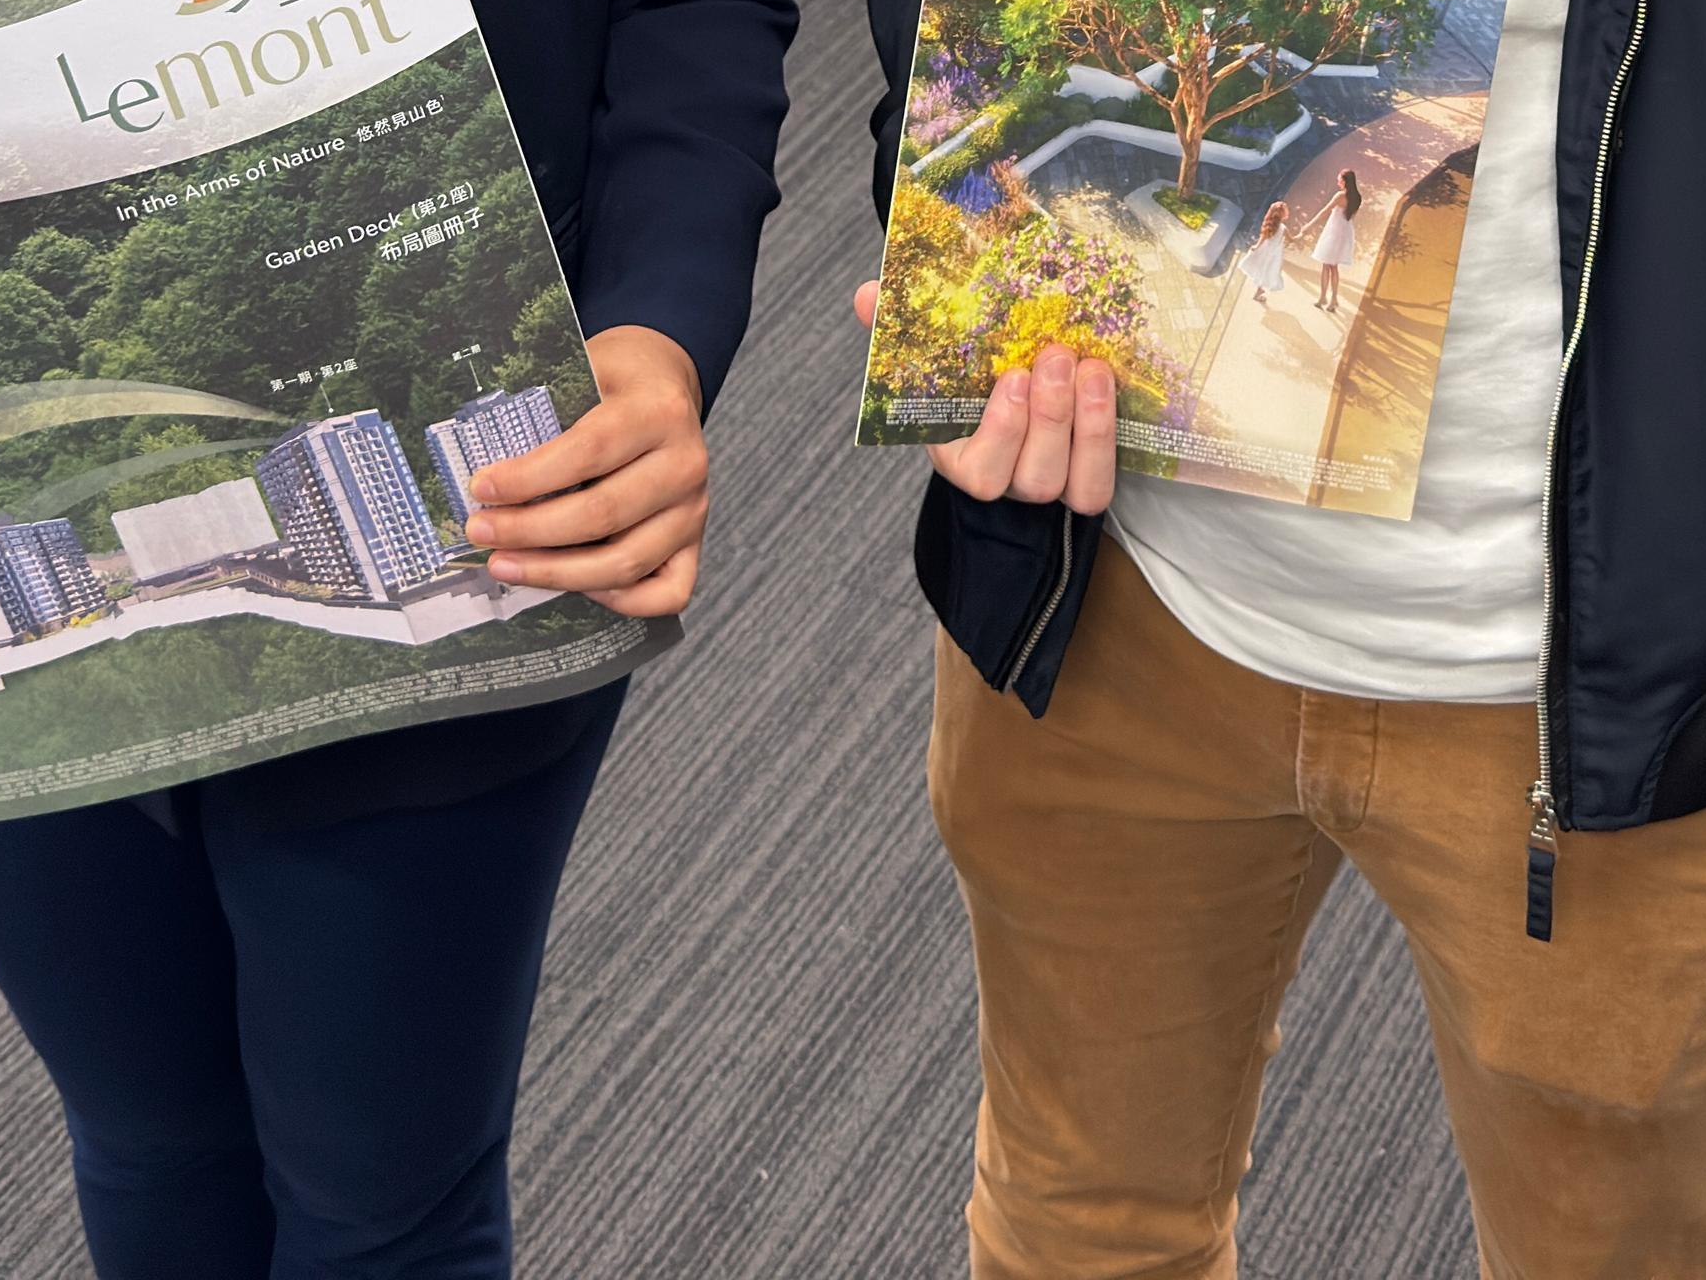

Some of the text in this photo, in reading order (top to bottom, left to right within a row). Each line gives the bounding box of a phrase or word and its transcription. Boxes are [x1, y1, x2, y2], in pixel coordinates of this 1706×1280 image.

[116, 203, 139, 222] In
[141, 191, 178, 215] the
[183, 174, 241, 202] Arms
[245, 160, 270, 181] of
[271, 136, 346, 171] Nature
[265, 234, 344, 270] Garden
[347, 212, 403, 245] Deck
[379, 206, 486, 264] 布局圖冊子
